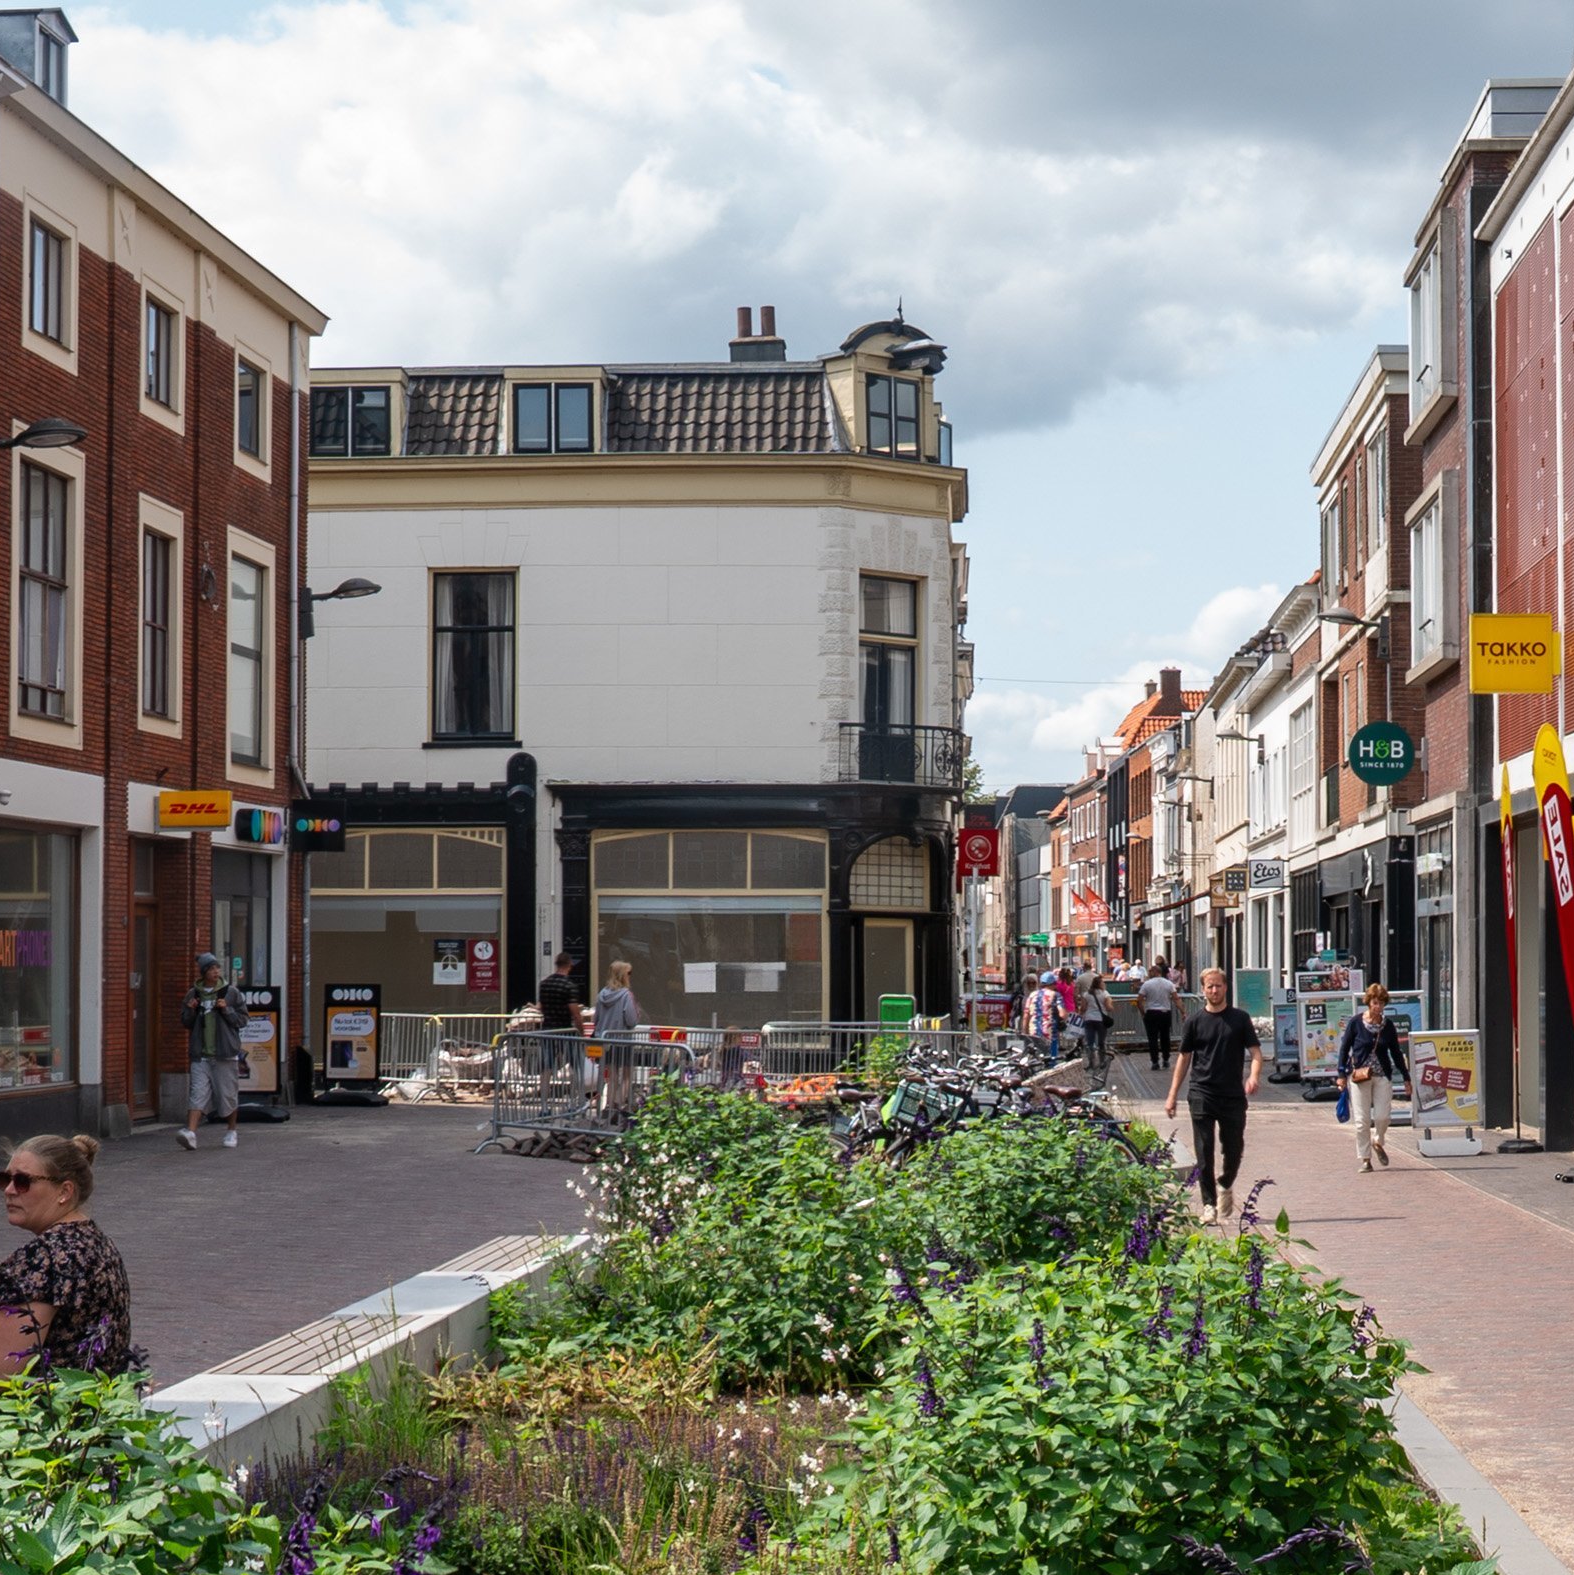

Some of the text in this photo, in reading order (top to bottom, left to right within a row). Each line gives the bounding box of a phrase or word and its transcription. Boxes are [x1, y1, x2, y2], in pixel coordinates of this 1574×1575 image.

[1359, 740, 1405, 758] H&B
[169, 803, 218, 815] DHL
[1253, 863, 1282, 879] Etos
